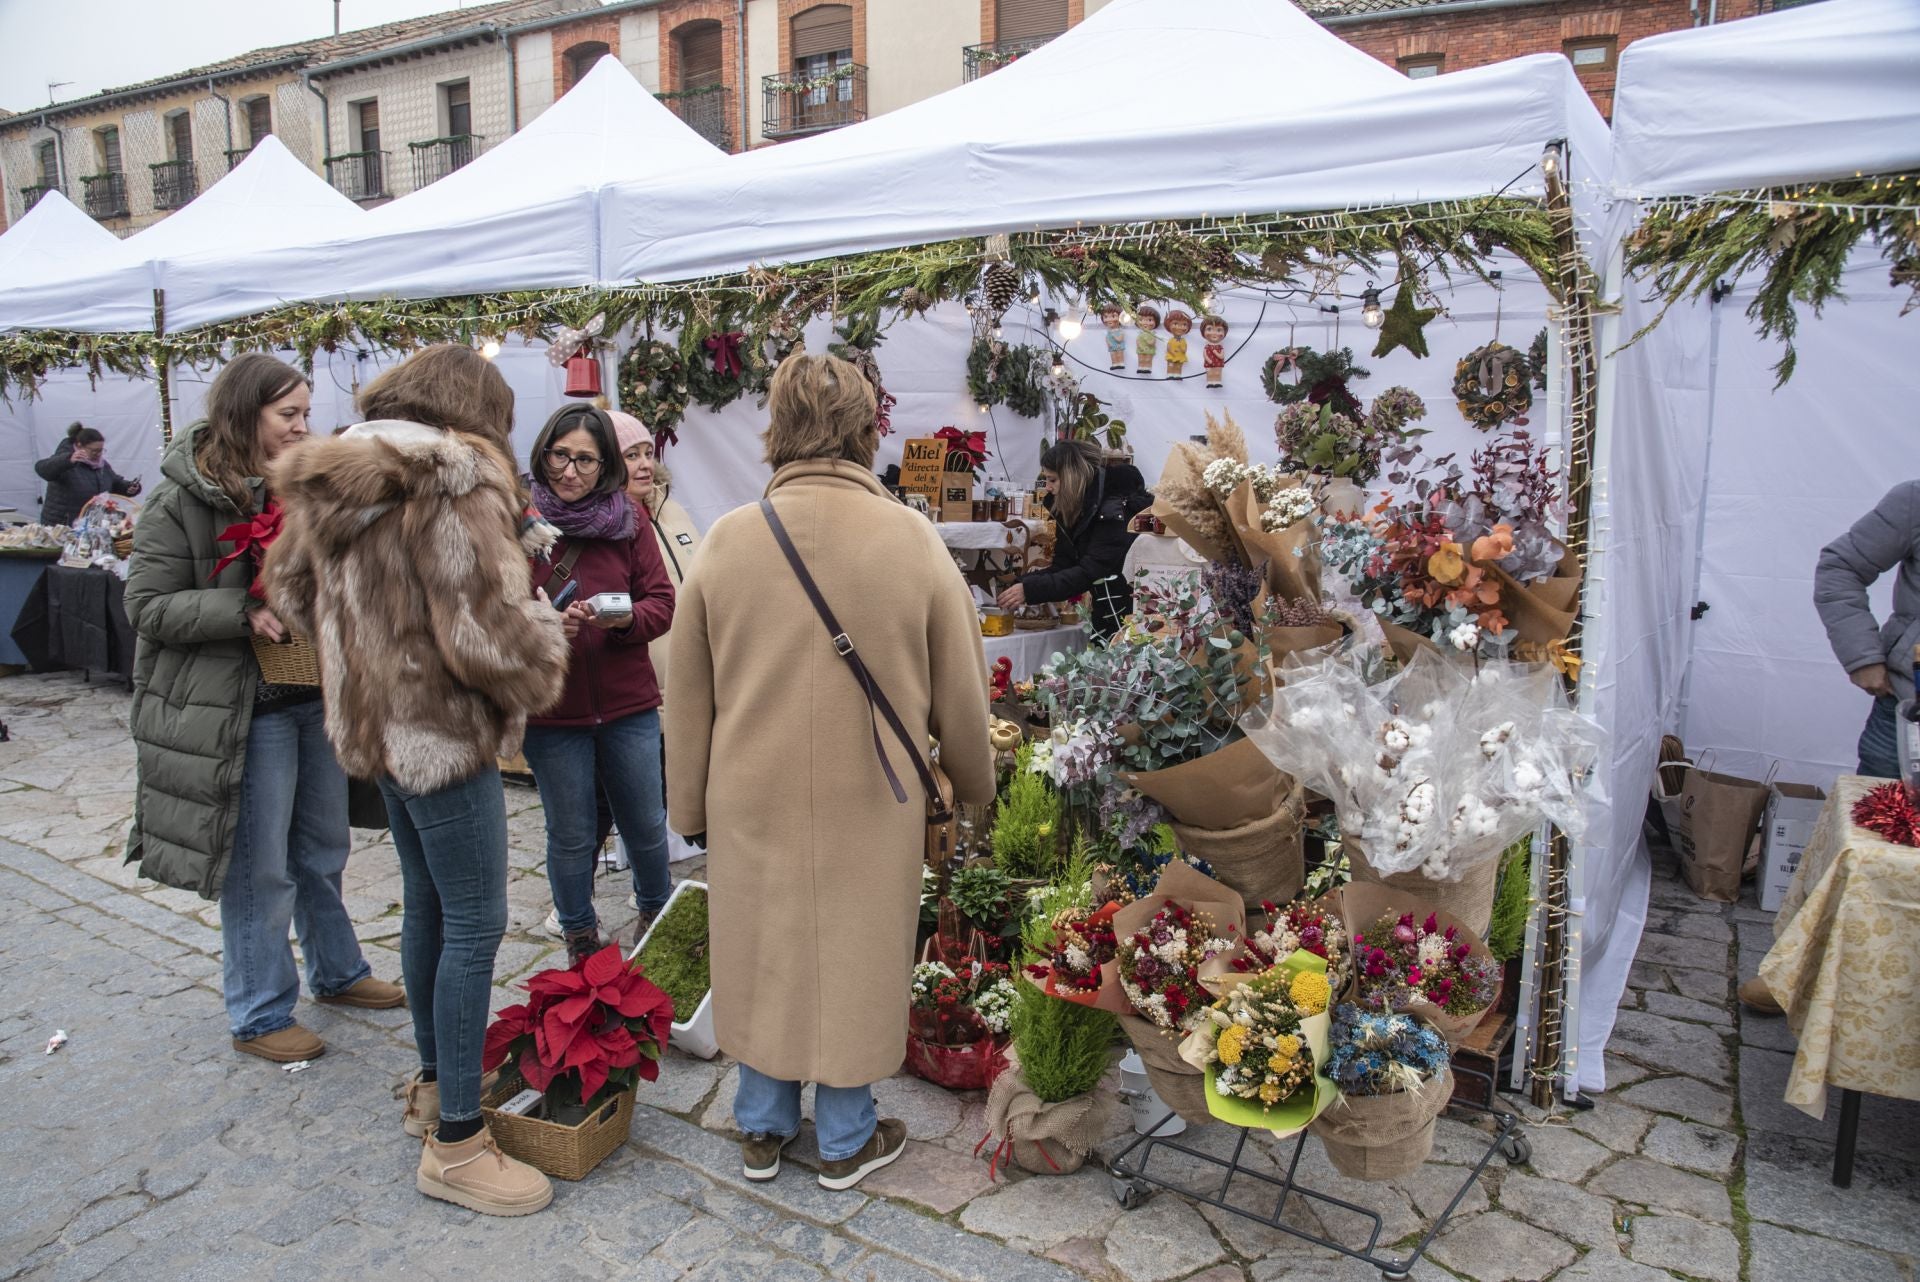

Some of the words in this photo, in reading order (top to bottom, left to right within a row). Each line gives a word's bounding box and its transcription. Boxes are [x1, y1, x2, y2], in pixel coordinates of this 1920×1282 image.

[906, 445, 940, 460] Miel
[908, 463, 940, 472] directa
[914, 473, 927, 482] del
[903, 484, 940, 493] picultor
